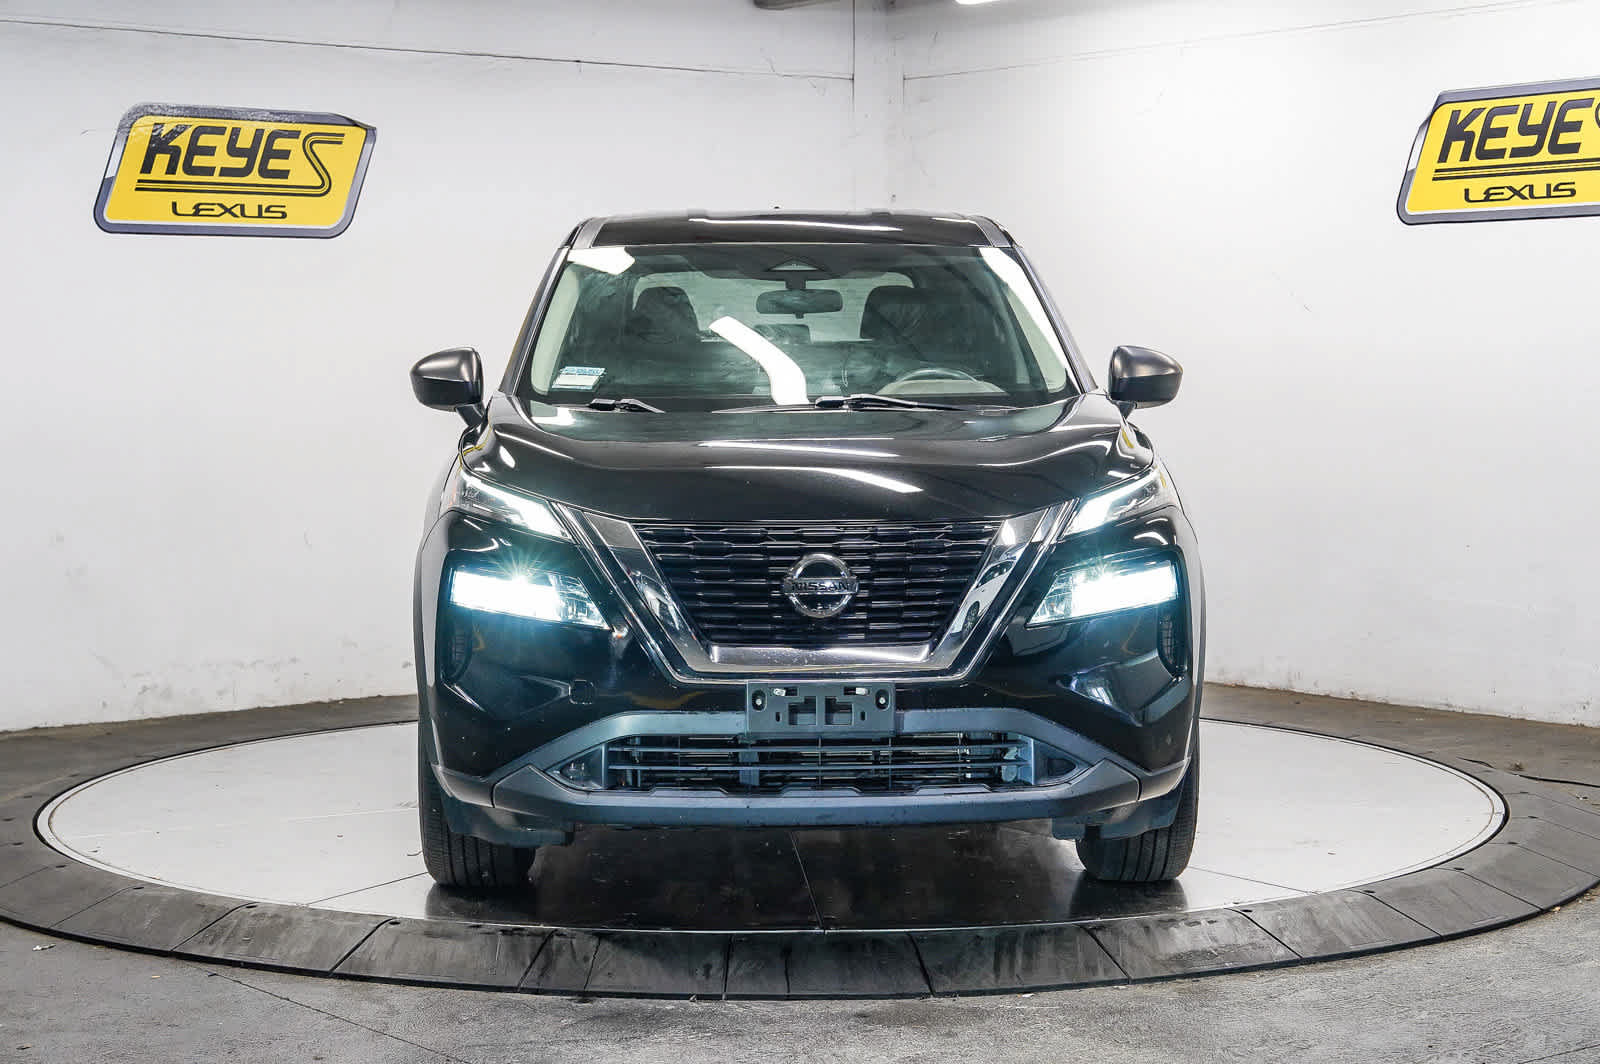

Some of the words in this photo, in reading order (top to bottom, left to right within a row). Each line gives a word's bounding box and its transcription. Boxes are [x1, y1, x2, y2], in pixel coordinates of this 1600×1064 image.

[1436, 97, 1600, 164] KEYE
[137, 122, 345, 194] KEYES
[1464, 182, 1576, 203] LEXUS
[171, 201, 287, 219] LEXUS
[791, 581, 849, 592] NISSAN
